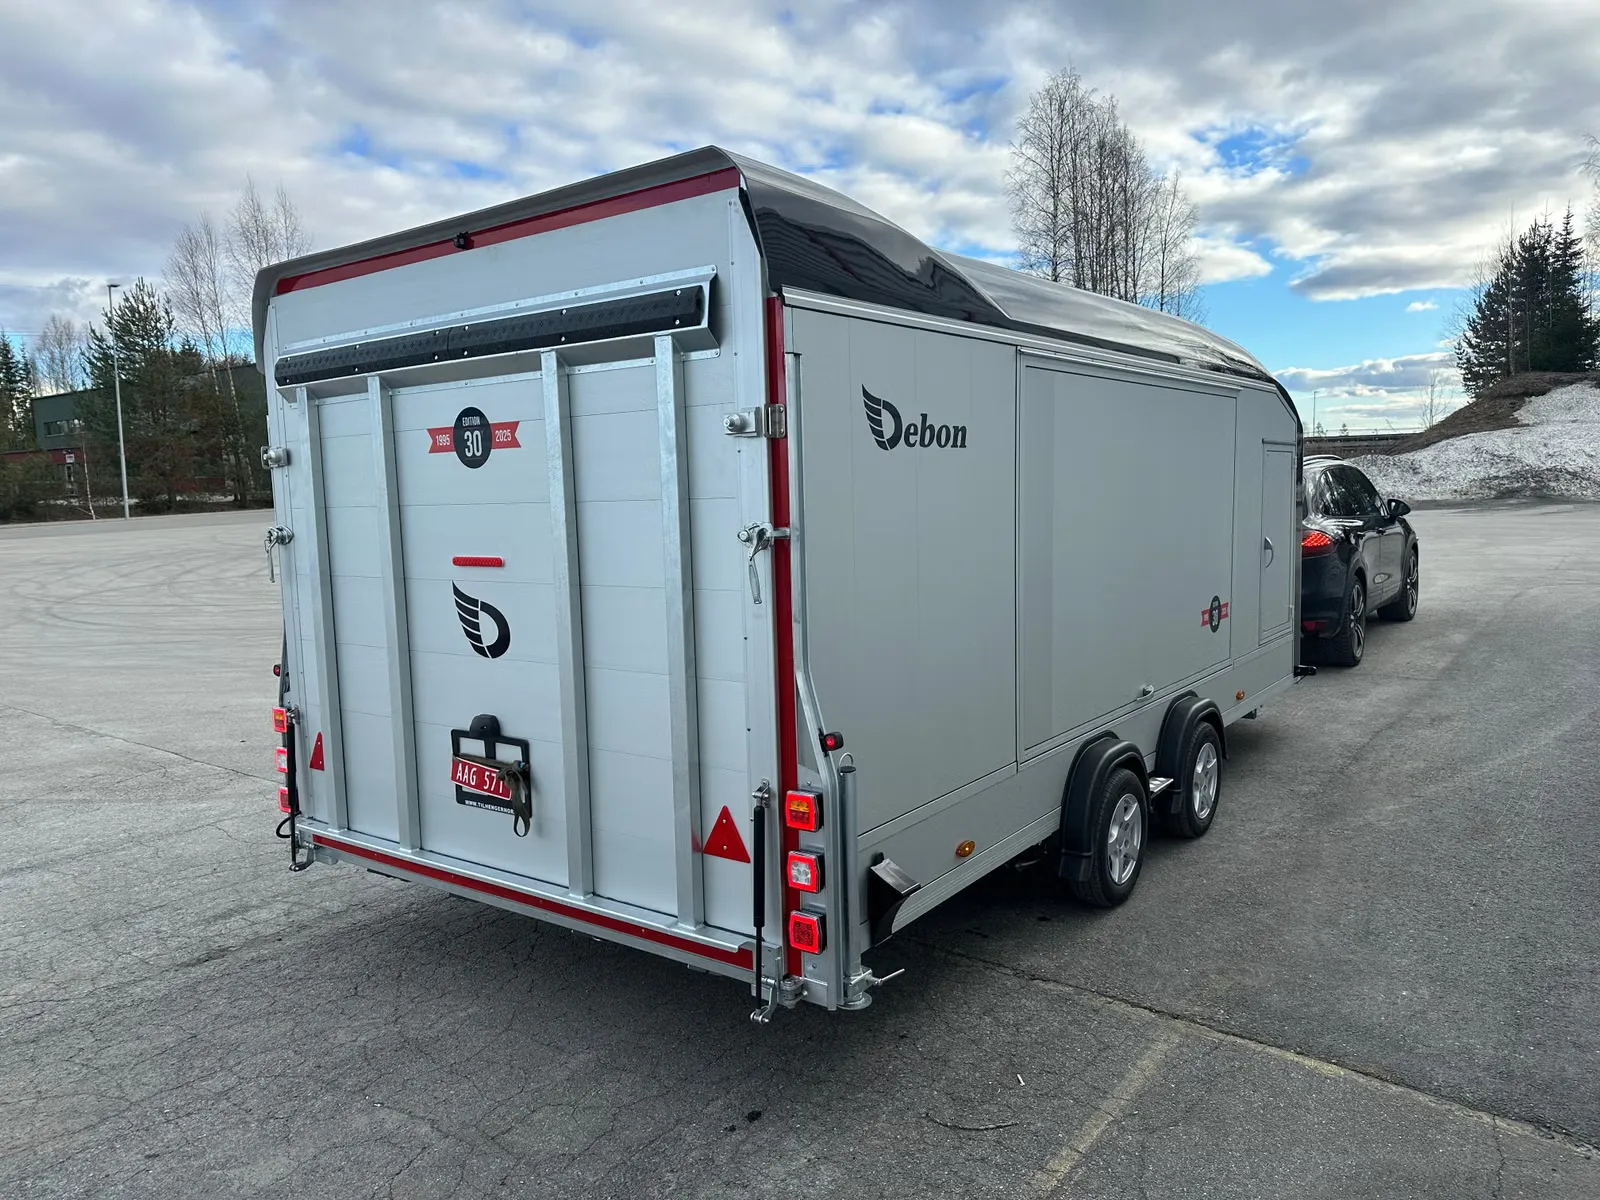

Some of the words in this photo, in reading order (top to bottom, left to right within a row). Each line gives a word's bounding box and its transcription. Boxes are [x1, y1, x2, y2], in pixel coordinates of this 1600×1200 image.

[462, 416, 480, 426] EDITION
[862, 383, 967, 451] Debon
[436, 434, 451, 446] 1995
[464, 430, 483, 457] 30
[495, 429, 512, 442] 2025
[456, 763, 477, 786] AAG
